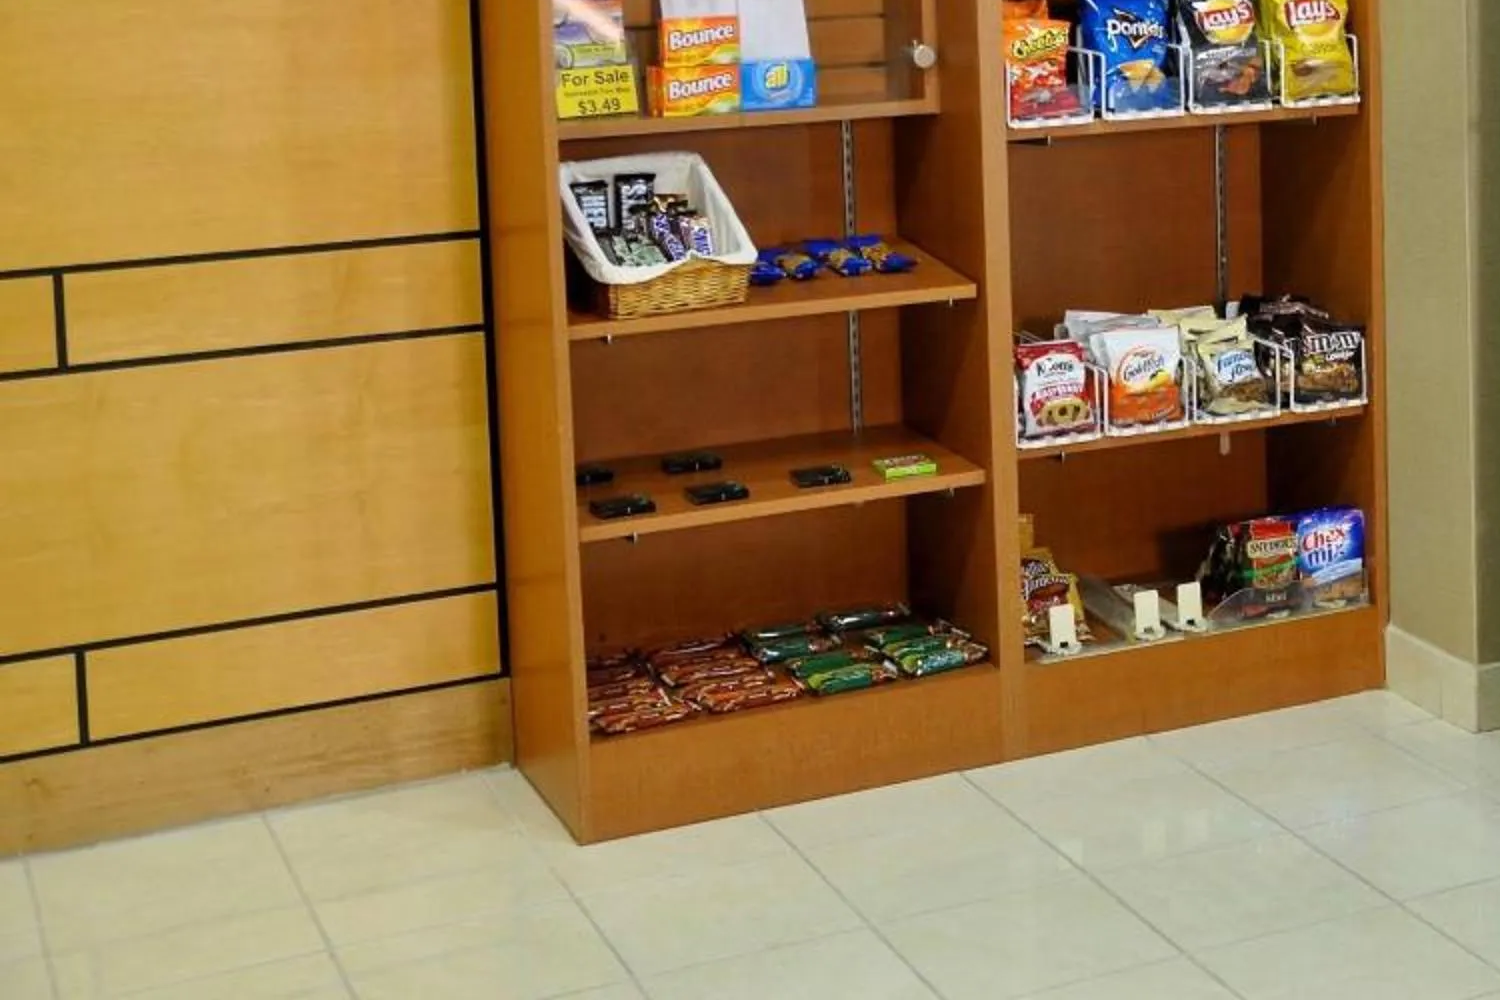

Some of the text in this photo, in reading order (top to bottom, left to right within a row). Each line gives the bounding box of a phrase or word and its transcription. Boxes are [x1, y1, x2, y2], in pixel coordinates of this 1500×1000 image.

[669, 24, 735, 51] Bounce
[561, 69, 630, 88] For Sale
[669, 73, 733, 99] Bounce
[1302, 526, 1346, 552] Chex
